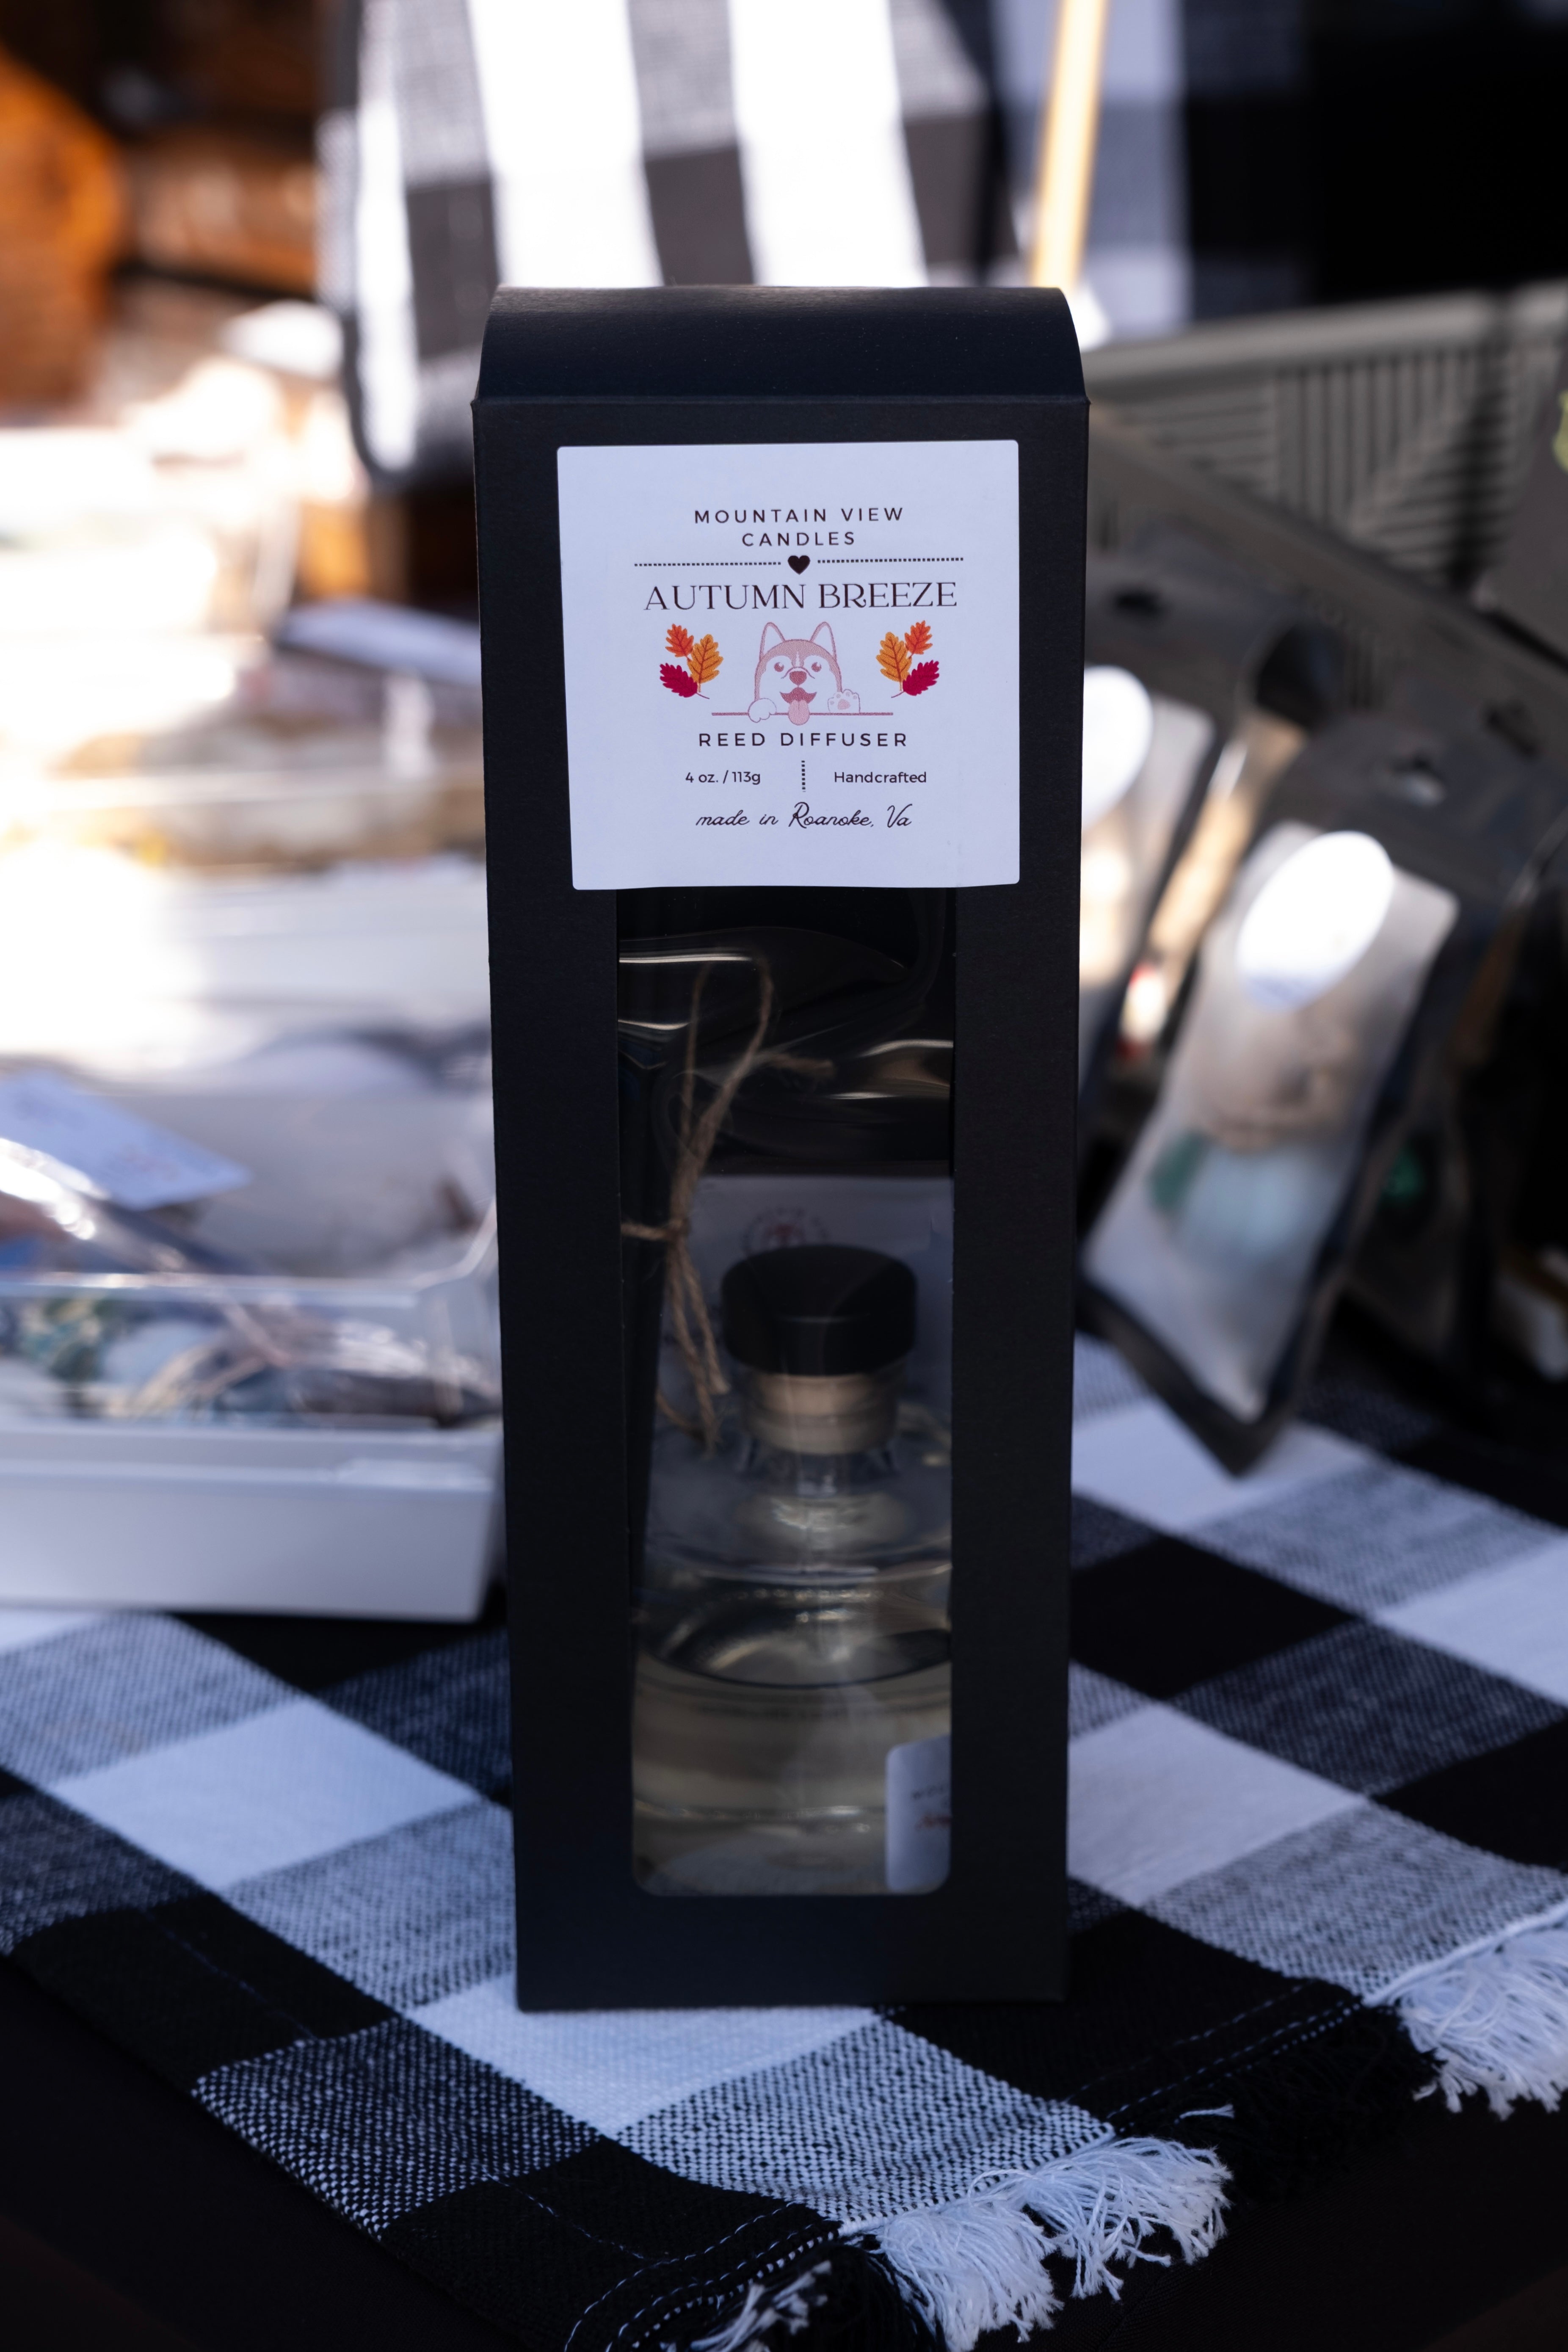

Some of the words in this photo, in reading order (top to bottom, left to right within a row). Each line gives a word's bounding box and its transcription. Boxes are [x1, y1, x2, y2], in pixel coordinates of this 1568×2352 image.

[694, 508, 826, 525] MOUNTAIN
[840, 507, 903, 522] VIEW
[741, 531, 855, 547] CANDLES
[643, 584, 806, 611] AUTUMN
[817, 581, 958, 609] BREEZE
[698, 732, 766, 747] REED
[780, 732, 907, 747] DIFFUSER
[685, 771, 695, 784] 4
[698, 773, 719, 784] oz.
[731, 771, 761, 786] 113g
[834, 771, 927, 784] Handcrafted
[694, 809, 751, 826] made
[758, 813, 779, 825] in
[787, 801, 874, 829] Roanoke,
[886, 803, 914, 829] Va
